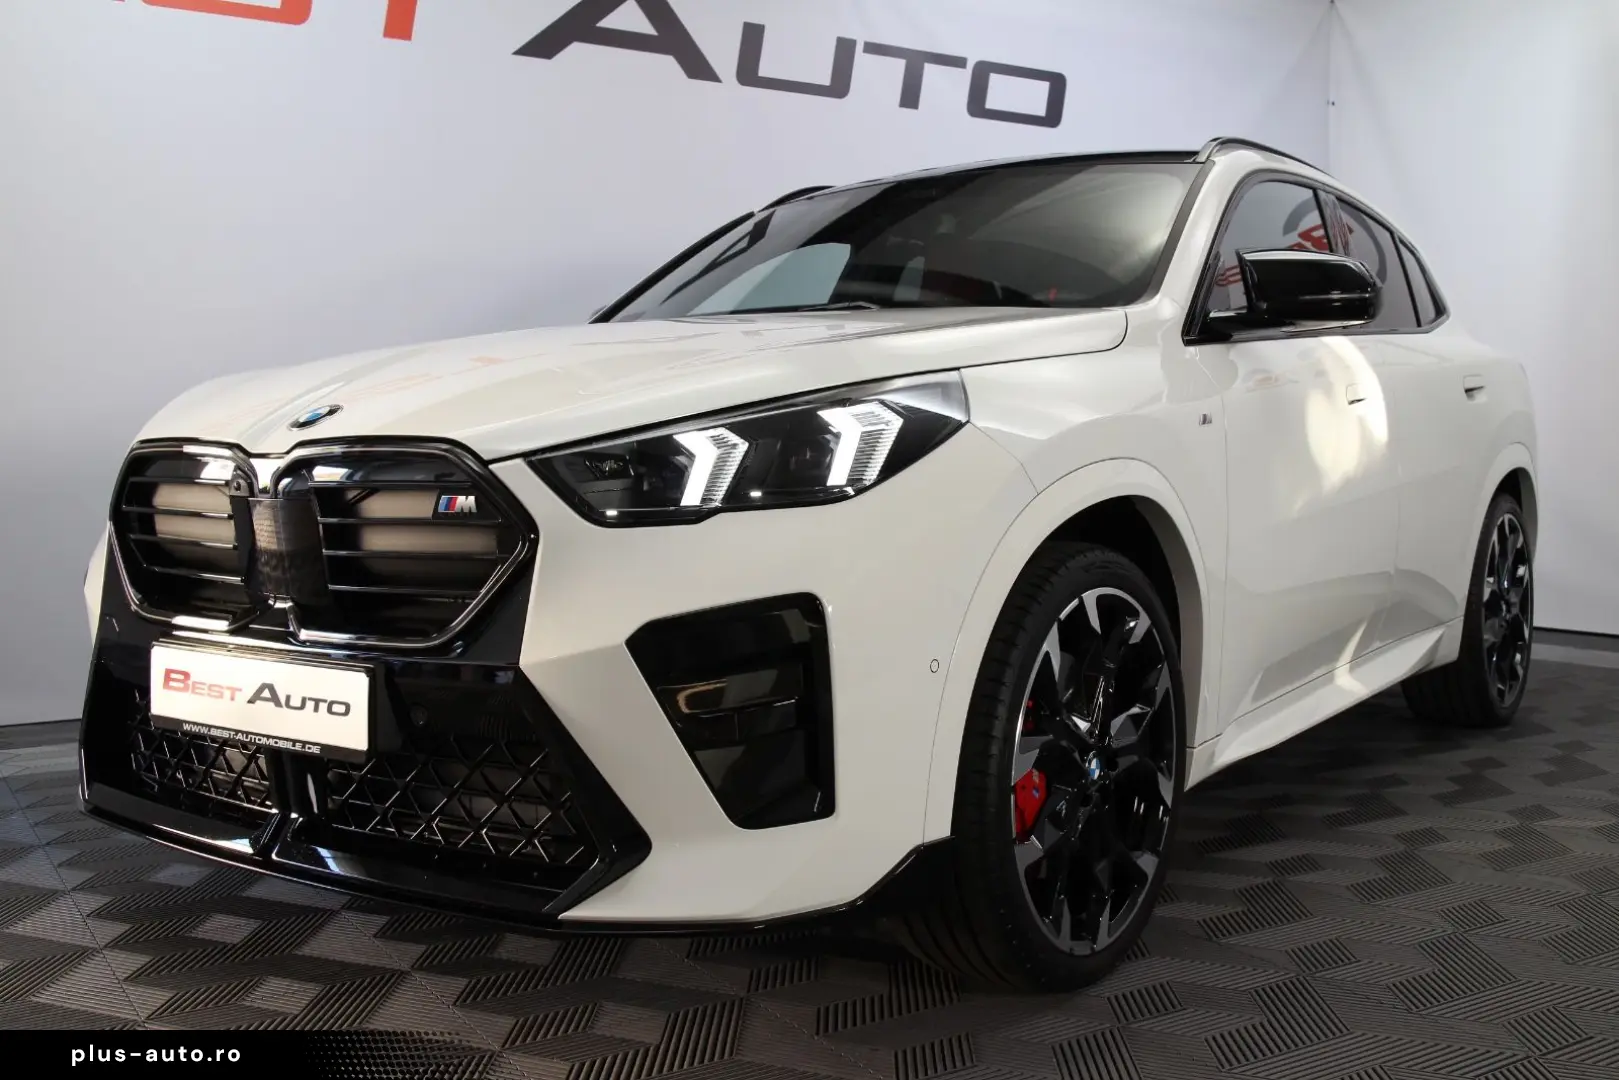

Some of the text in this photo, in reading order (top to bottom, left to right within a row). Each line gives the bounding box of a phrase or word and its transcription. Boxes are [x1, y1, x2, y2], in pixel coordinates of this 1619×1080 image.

[162, 667, 352, 718] BEST AUTO
[182, 722, 322, 755] WWW.BEST-AUTOMOBILE.DE
